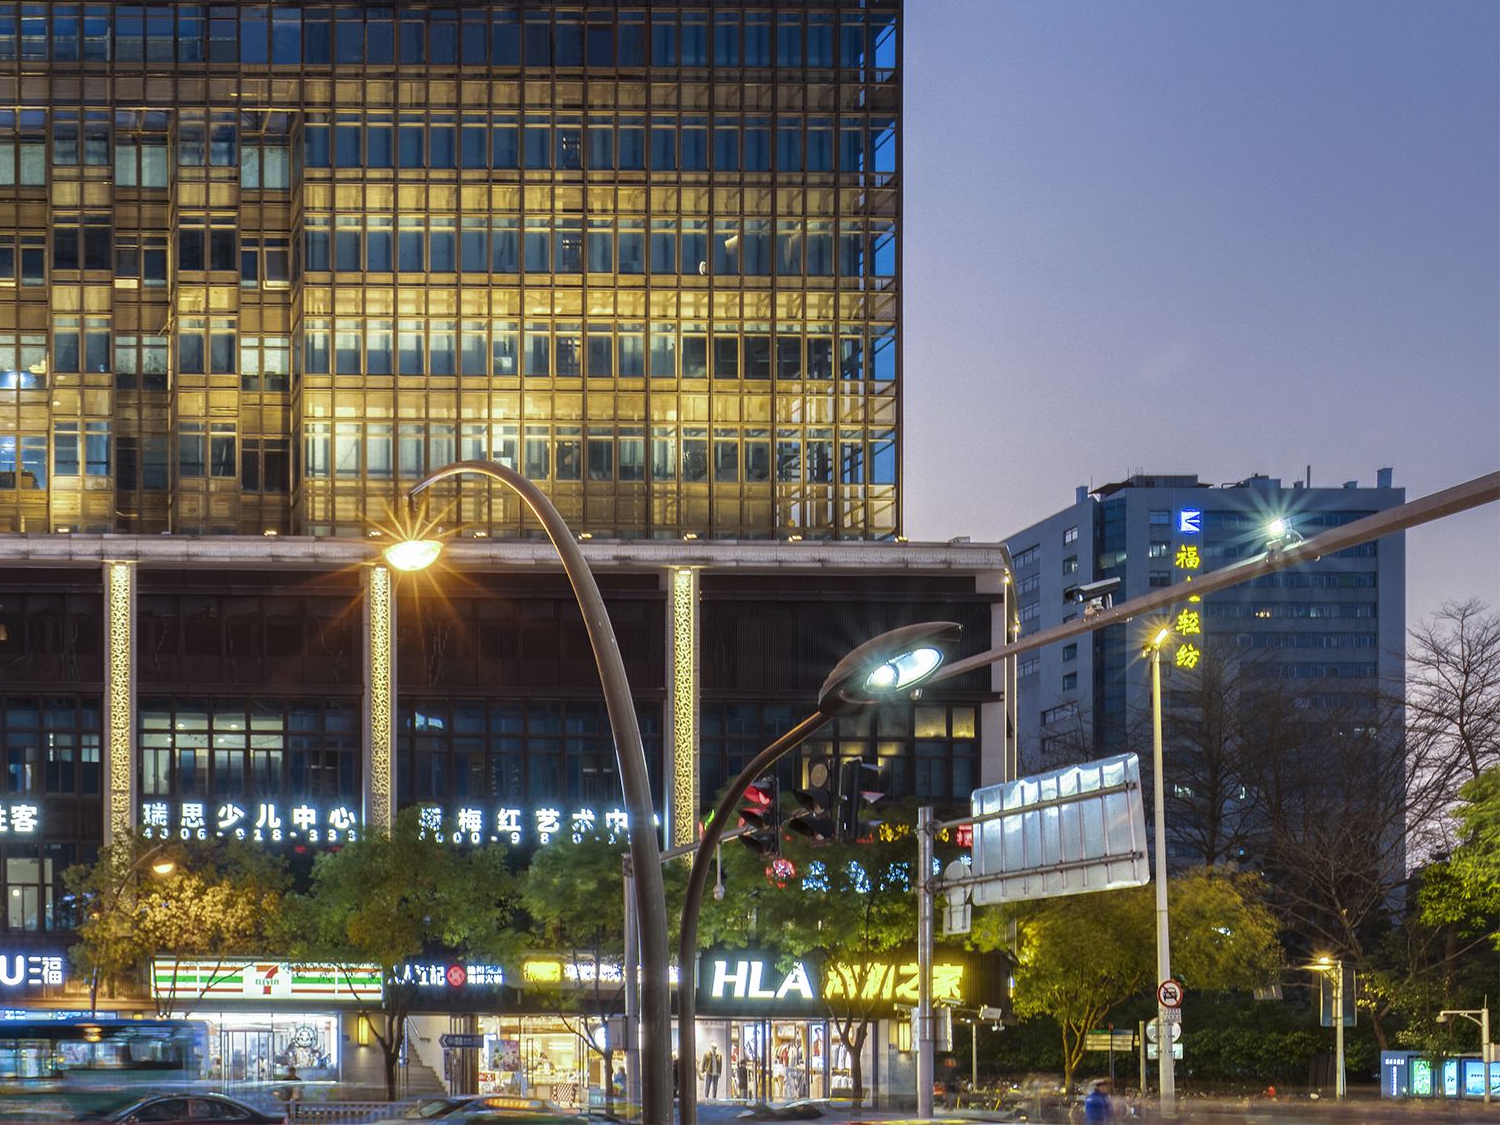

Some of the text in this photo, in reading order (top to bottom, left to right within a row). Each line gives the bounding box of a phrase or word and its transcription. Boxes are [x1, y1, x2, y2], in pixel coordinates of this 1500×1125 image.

[1175, 544, 1201, 669] 福轻纺
[142, 802, 356, 830] 瑞思少儿中心
[418, 808, 660, 833] 杨梅红艺术中
[28, 956, 63, 985] 三福
[256, 965, 279, 995] 7
[711, 960, 814, 999] HLA
